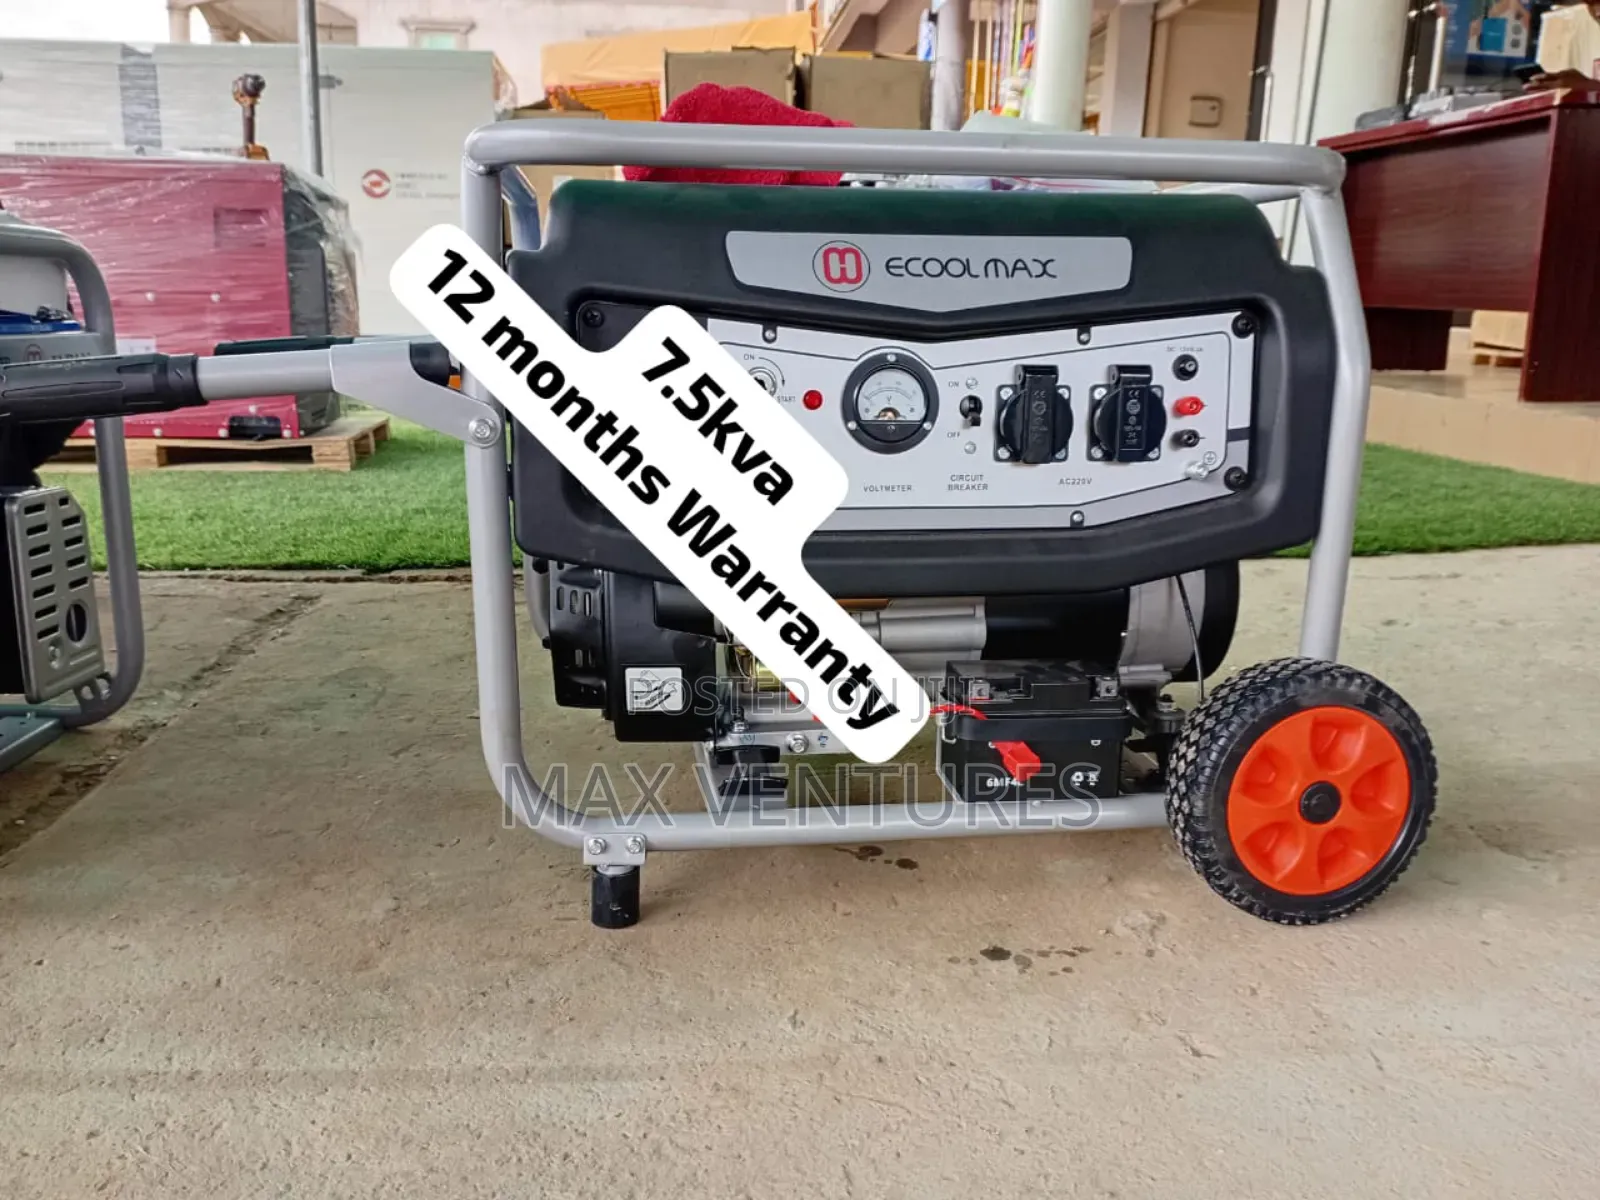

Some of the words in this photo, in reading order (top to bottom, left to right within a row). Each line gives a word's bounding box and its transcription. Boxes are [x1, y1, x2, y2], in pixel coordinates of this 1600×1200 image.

[743, 353, 755, 361] ON
[948, 380, 960, 388] ON
[950, 474, 984, 482] CIRCUIT
[1058, 478, 1093, 486] AC220V
[863, 484, 913, 493] VOLTMETER
[947, 482, 989, 491] BREAKER
